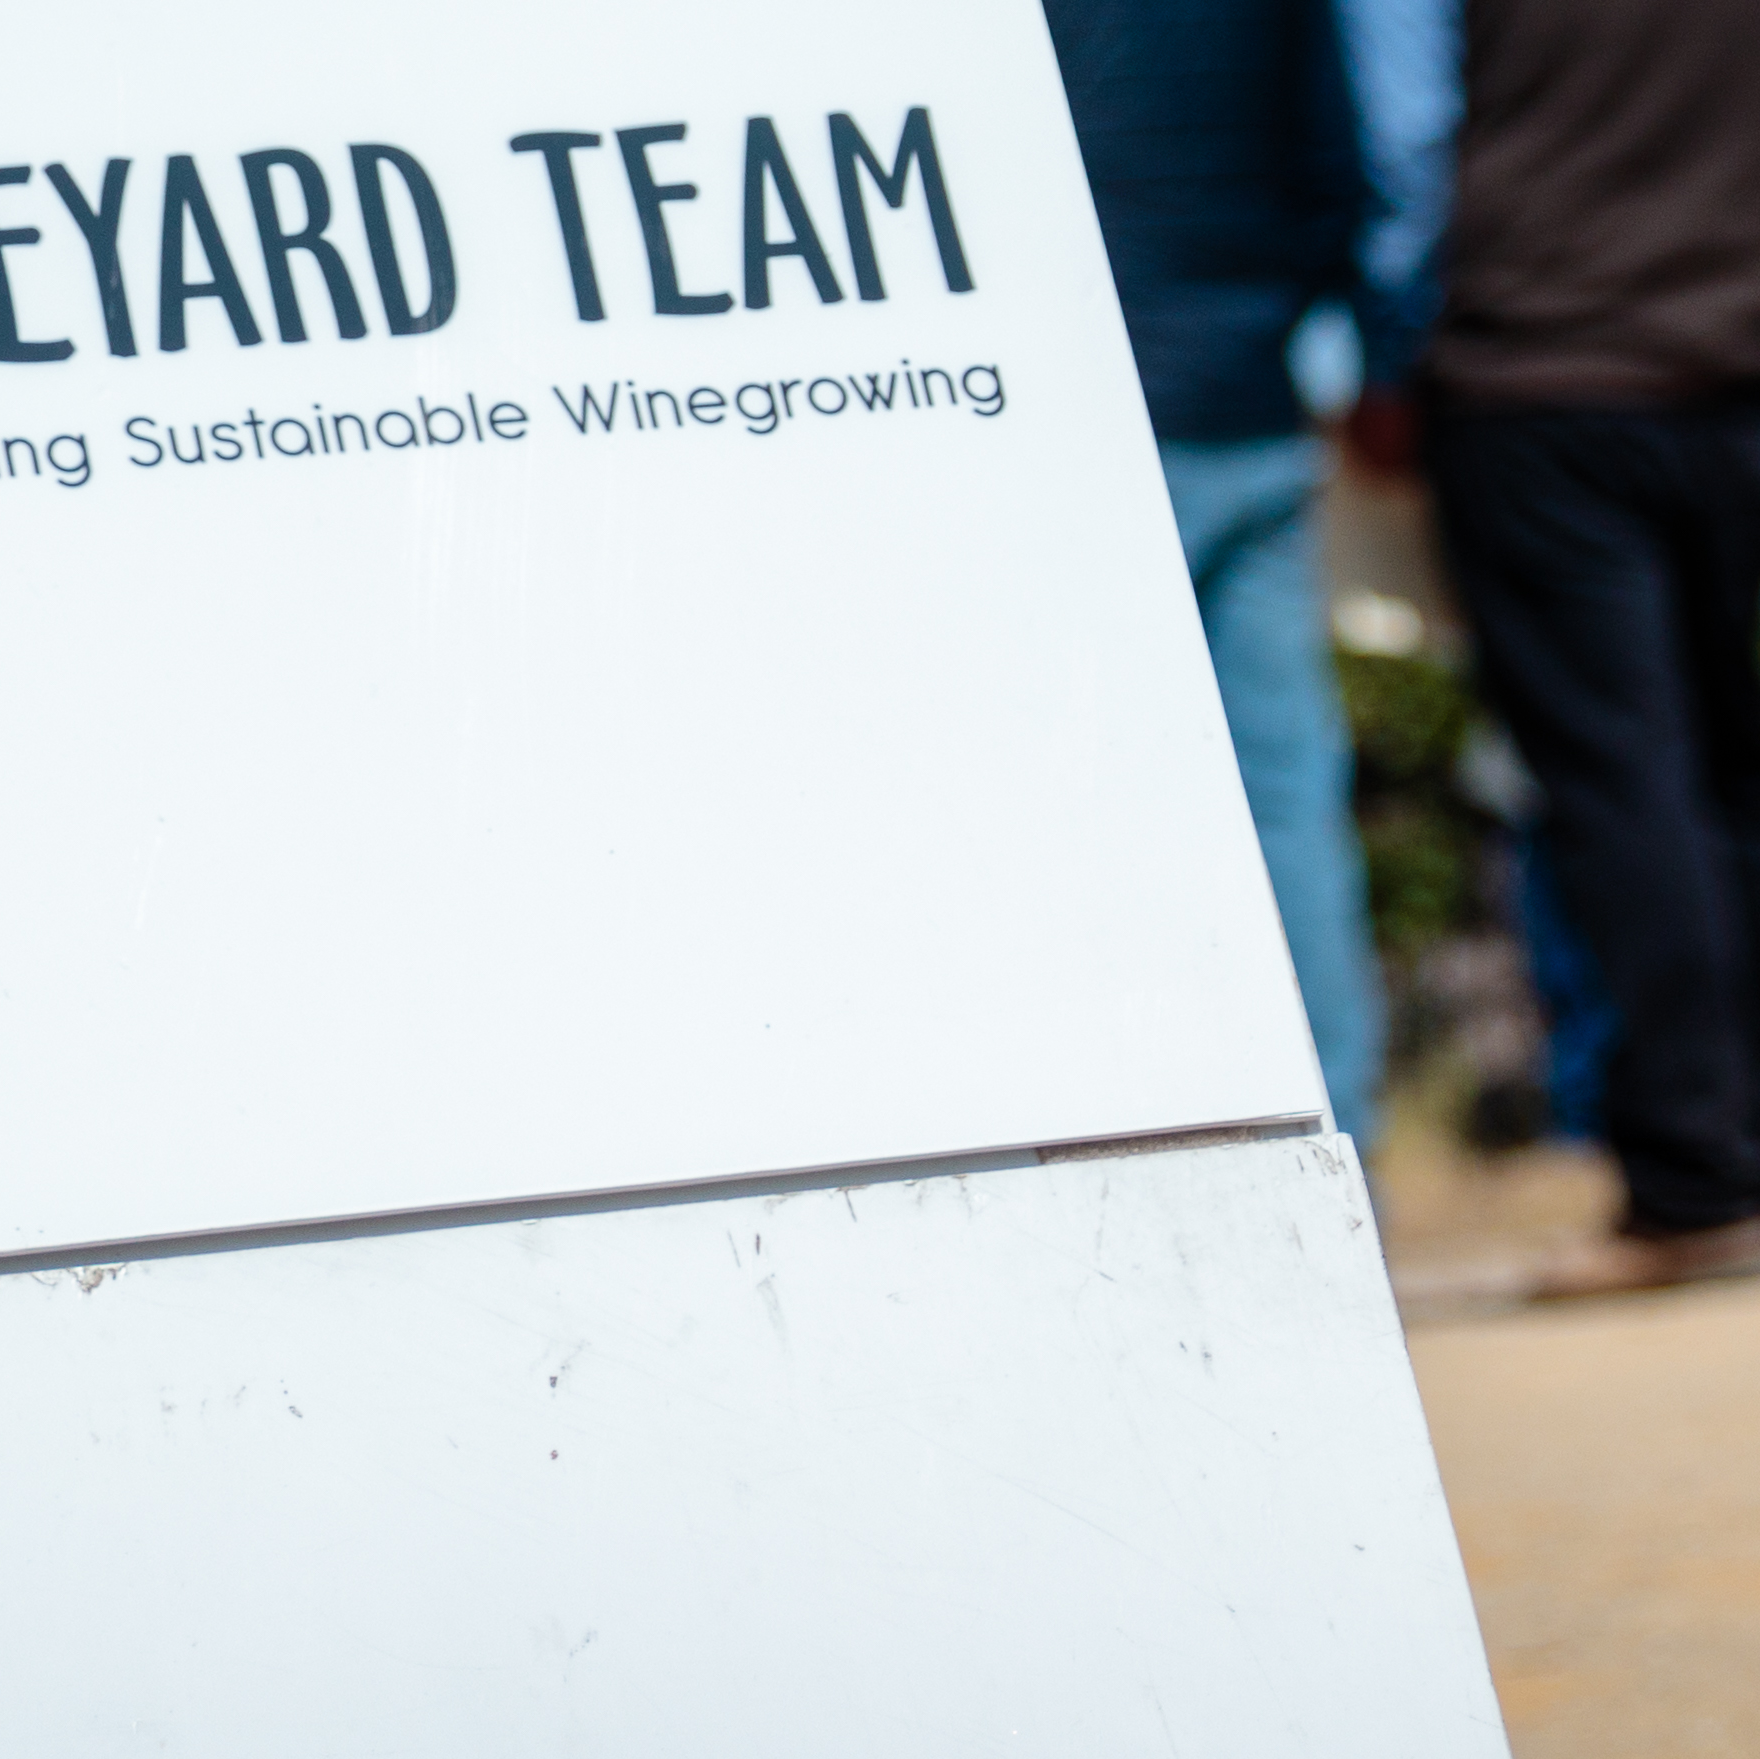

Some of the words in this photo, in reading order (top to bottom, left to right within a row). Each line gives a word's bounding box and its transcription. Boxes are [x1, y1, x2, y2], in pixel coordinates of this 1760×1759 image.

[509, 106, 976, 322] TEAM
[125, 392, 529, 467] Sustainable
[552, 358, 1005, 435] Winegrowing
